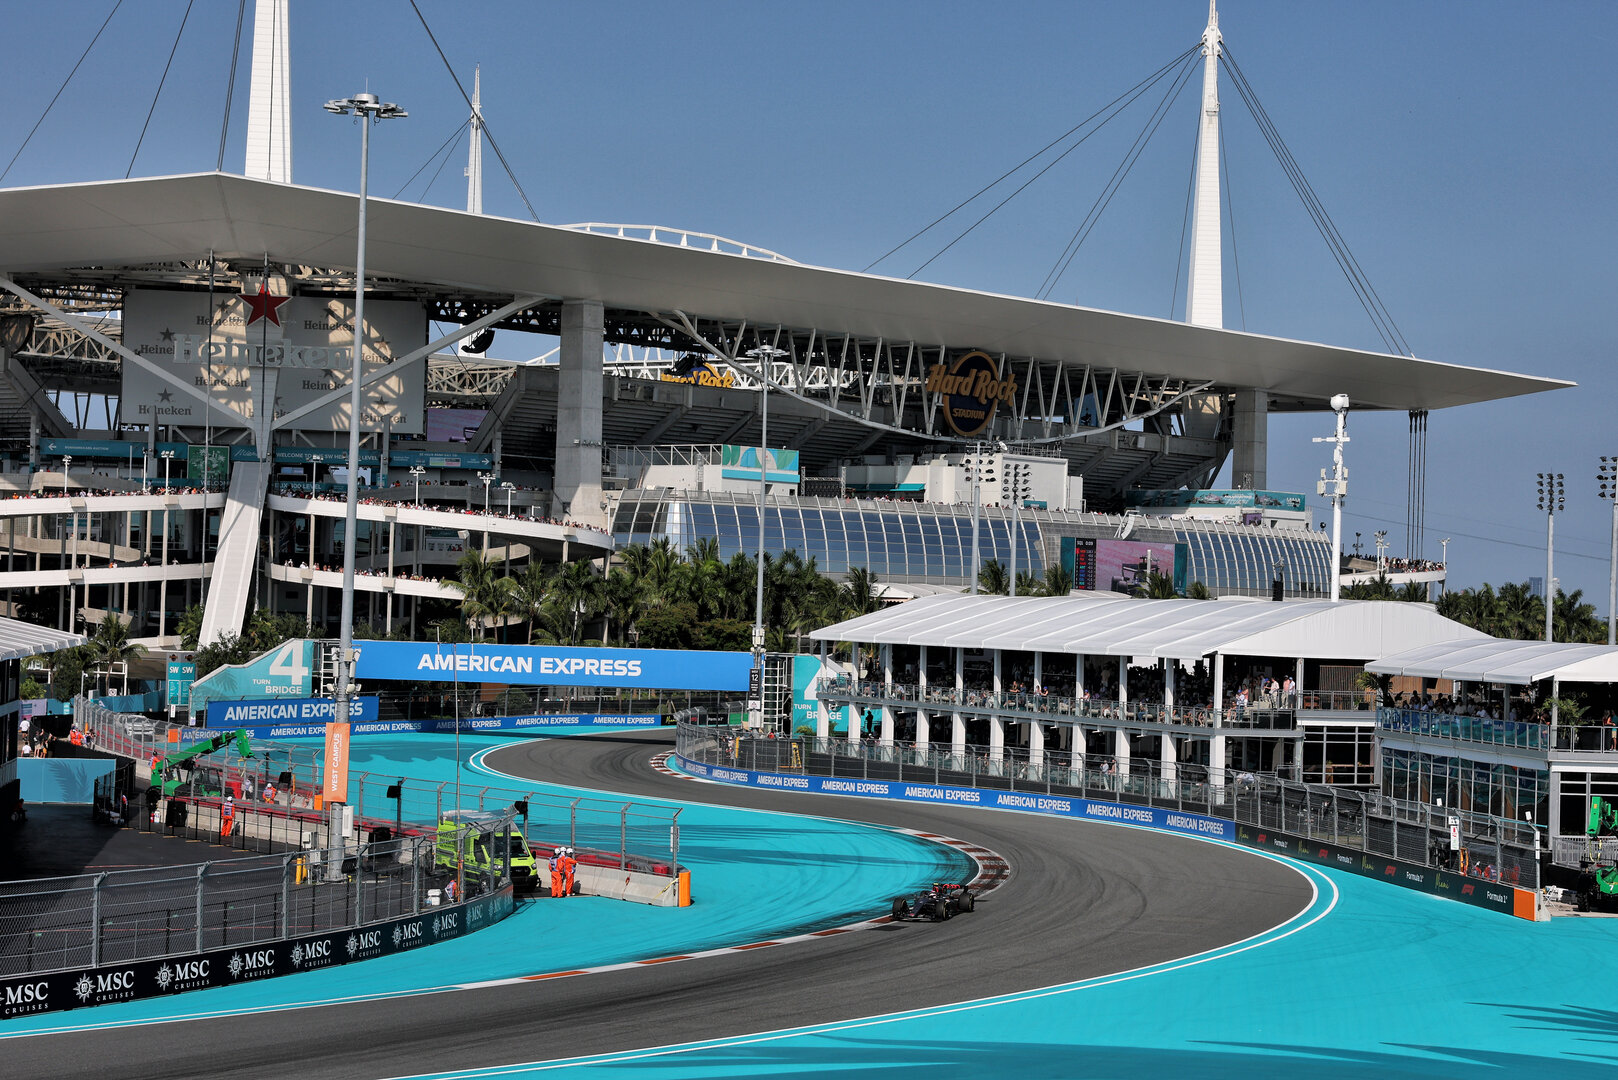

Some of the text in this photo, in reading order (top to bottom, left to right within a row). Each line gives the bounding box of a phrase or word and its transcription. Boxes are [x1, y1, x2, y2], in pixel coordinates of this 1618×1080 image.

[173, 333, 355, 370] Heineken
[926, 364, 1018, 407] Hard Rock
[952, 408, 984, 420] STADIUM
[269, 639, 308, 685] 4
[417, 654, 642, 677] AMERICAN EXPRESS
[265, 686, 302, 694] BRIDGE
[224, 702, 363, 721] AMERICAN EXPRSS
[806, 711, 842, 720] BRGE
[355, 722, 421, 733] AMERICAN EXPRESS
[436, 720, 501, 729] AMERICAN EXPRESS
[516, 718, 549, 726] AMERICAN
[182, 730, 220, 740] AMERICAN
[270, 727, 326, 736] AMERICAN EXPR
[712, 768, 748, 782] AMERICAN EXPRESS
[757, 775, 809, 788] AMERICAN EXPRESS
[821, 780, 889, 794] AMERICAN EXPRESS
[905, 786, 980, 802] AMERICAN EXPRESS
[997, 794, 1070, 812] AMERICAN EXPRESS
[1086, 804, 1153, 822] AMERICAN EXPRESS
[1166, 814, 1223, 835] AMERICAN EXPRESS
[1487, 890, 1503, 902] Formula
[441, 913, 457, 930] MSC
[402, 922, 422, 940] MSC
[359, 930, 381, 949] MSC
[402, 939, 422, 948] CRUISES
[305, 940, 331, 959] MSC
[359, 949, 381, 958] CRUISES
[244, 950, 274, 970] MSC
[304, 959, 331, 968] CRUISES
[175, 960, 209, 981] MSC
[244, 969, 274, 978] CRUISES
[97, 971, 134, 993] MSC
[174, 979, 209, 990] CRUISES
[6, 982, 48, 1005] MSC
[96, 991, 134, 1002] CRUISES
[5, 1003, 48, 1014] CRUISES
